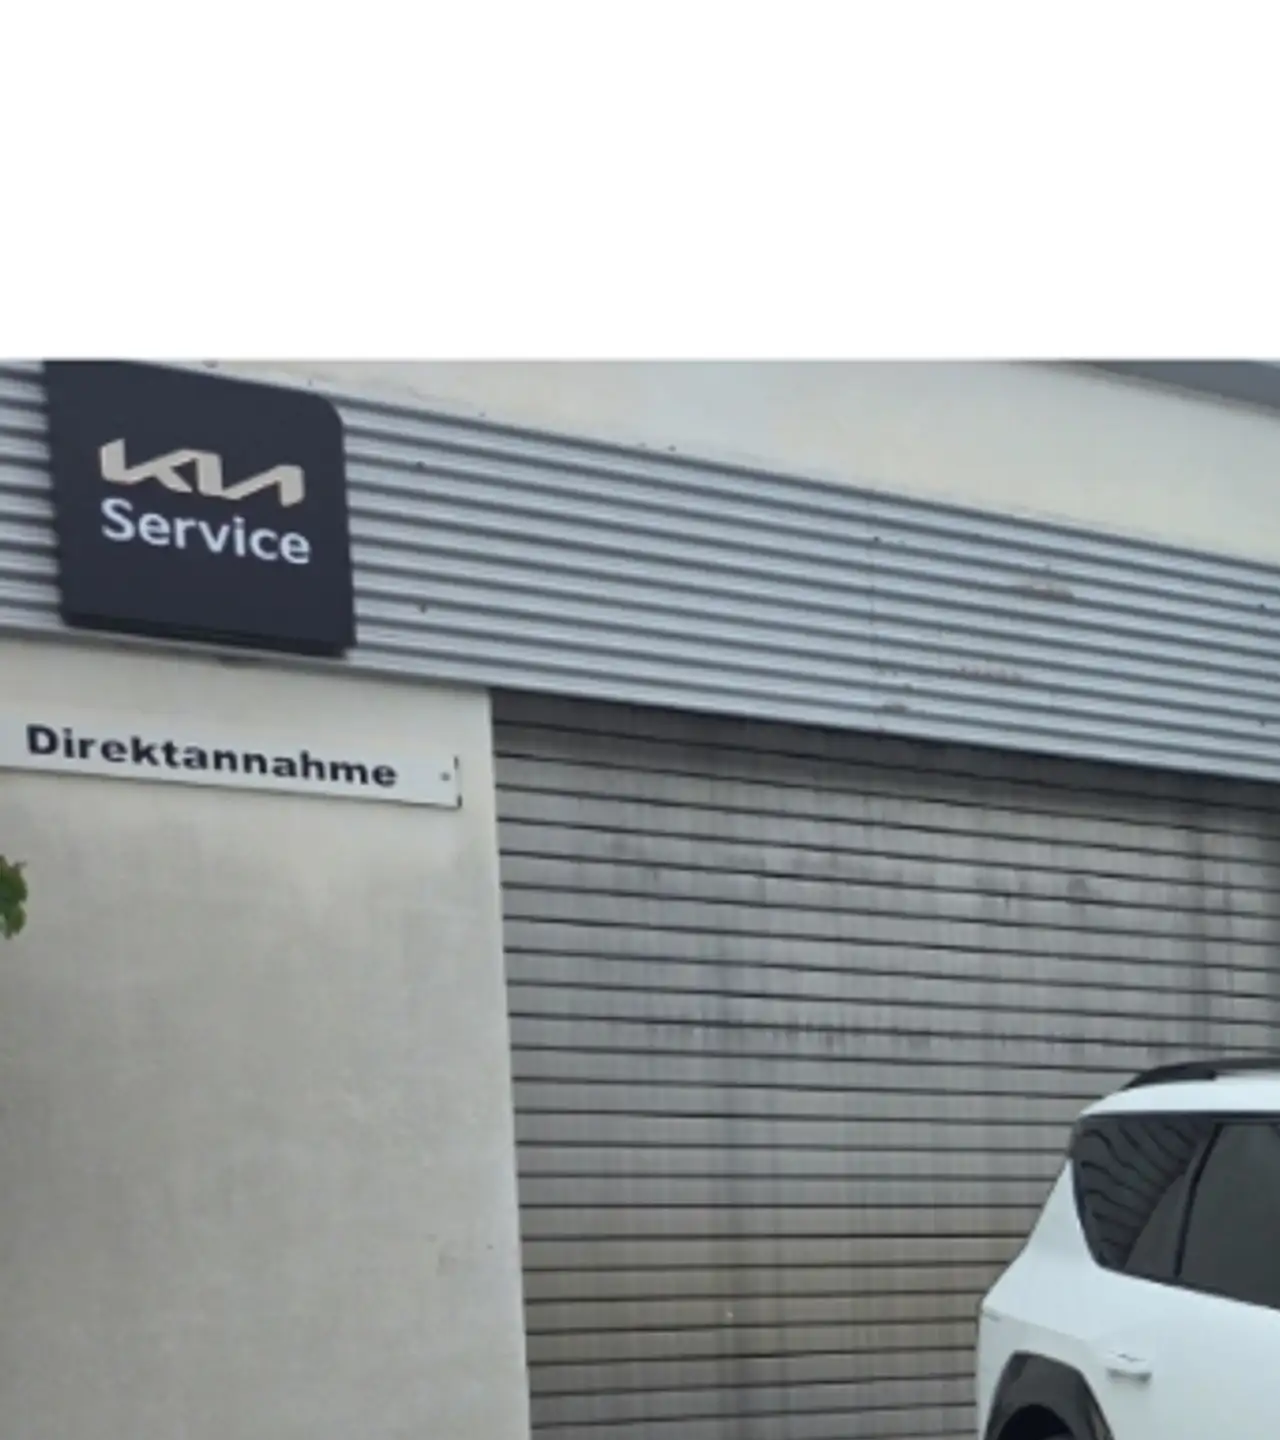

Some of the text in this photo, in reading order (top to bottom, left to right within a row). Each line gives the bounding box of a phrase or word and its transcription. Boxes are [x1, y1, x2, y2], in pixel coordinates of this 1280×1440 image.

[99, 438, 305, 507] KIA
[101, 498, 311, 565] Service
[26, 723, 397, 788] Direktannahme
